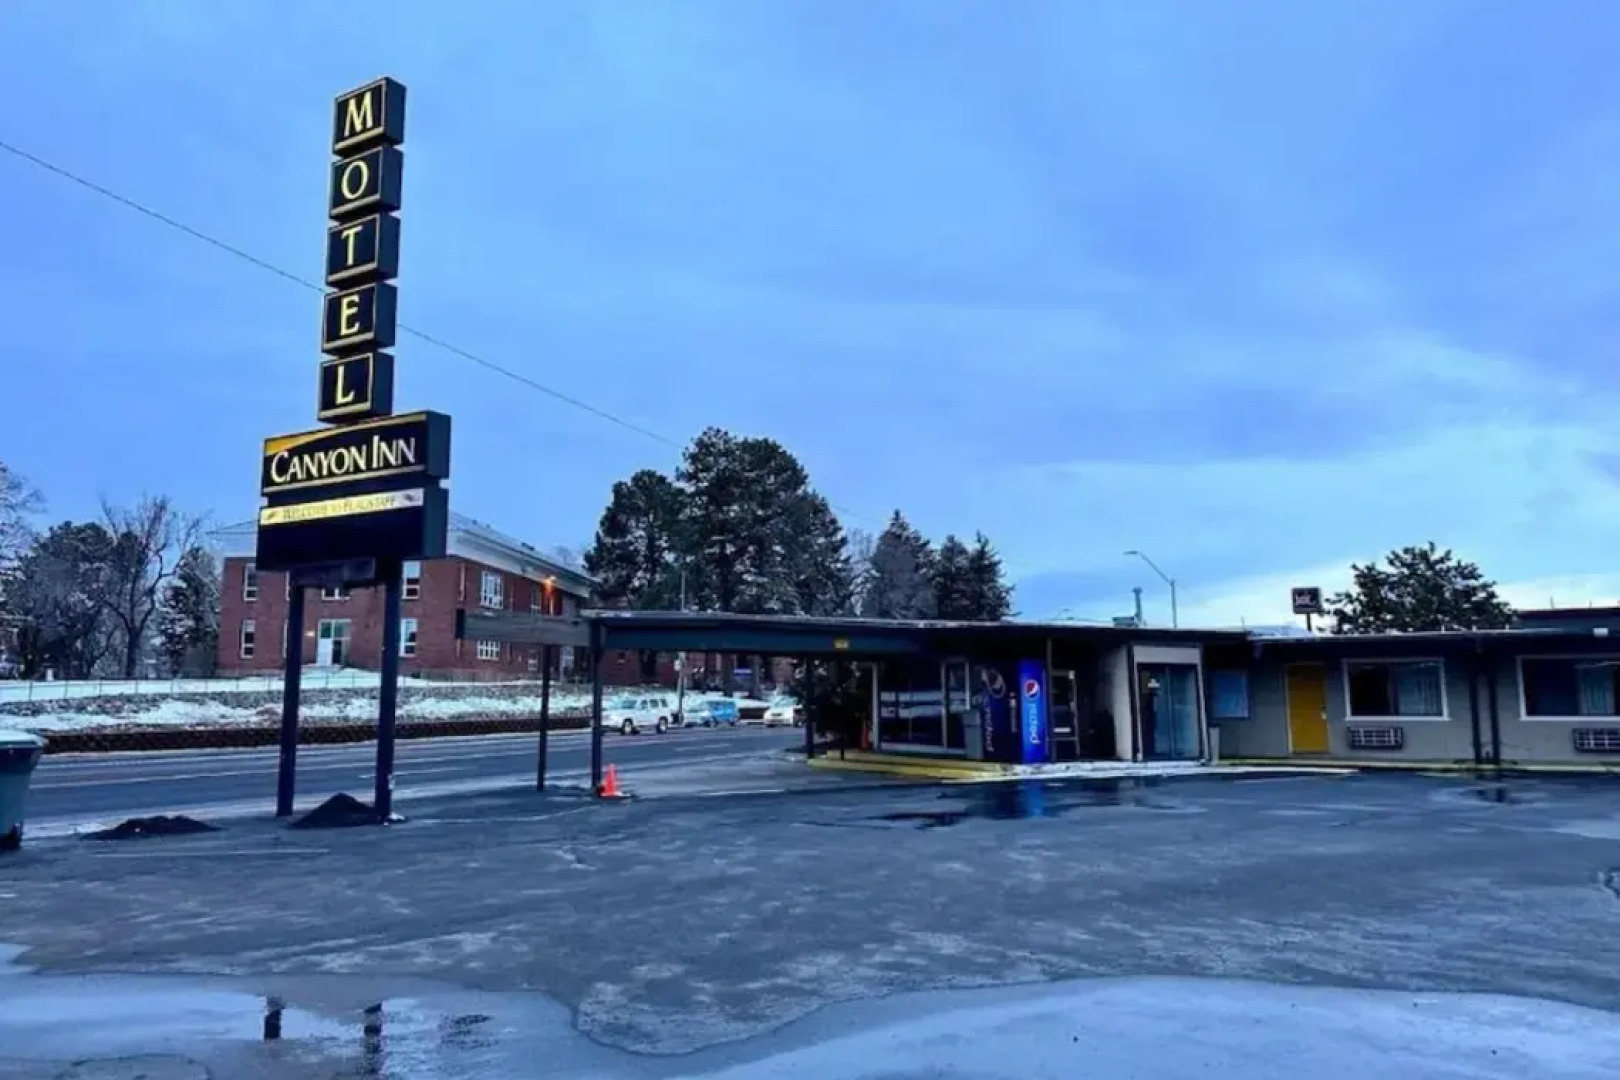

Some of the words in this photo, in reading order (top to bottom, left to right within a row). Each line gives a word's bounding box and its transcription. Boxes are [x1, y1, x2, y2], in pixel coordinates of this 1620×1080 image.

[334, 90, 374, 406] MOTEL
[270, 444, 367, 484] CANYON
[371, 434, 416, 469] INN
